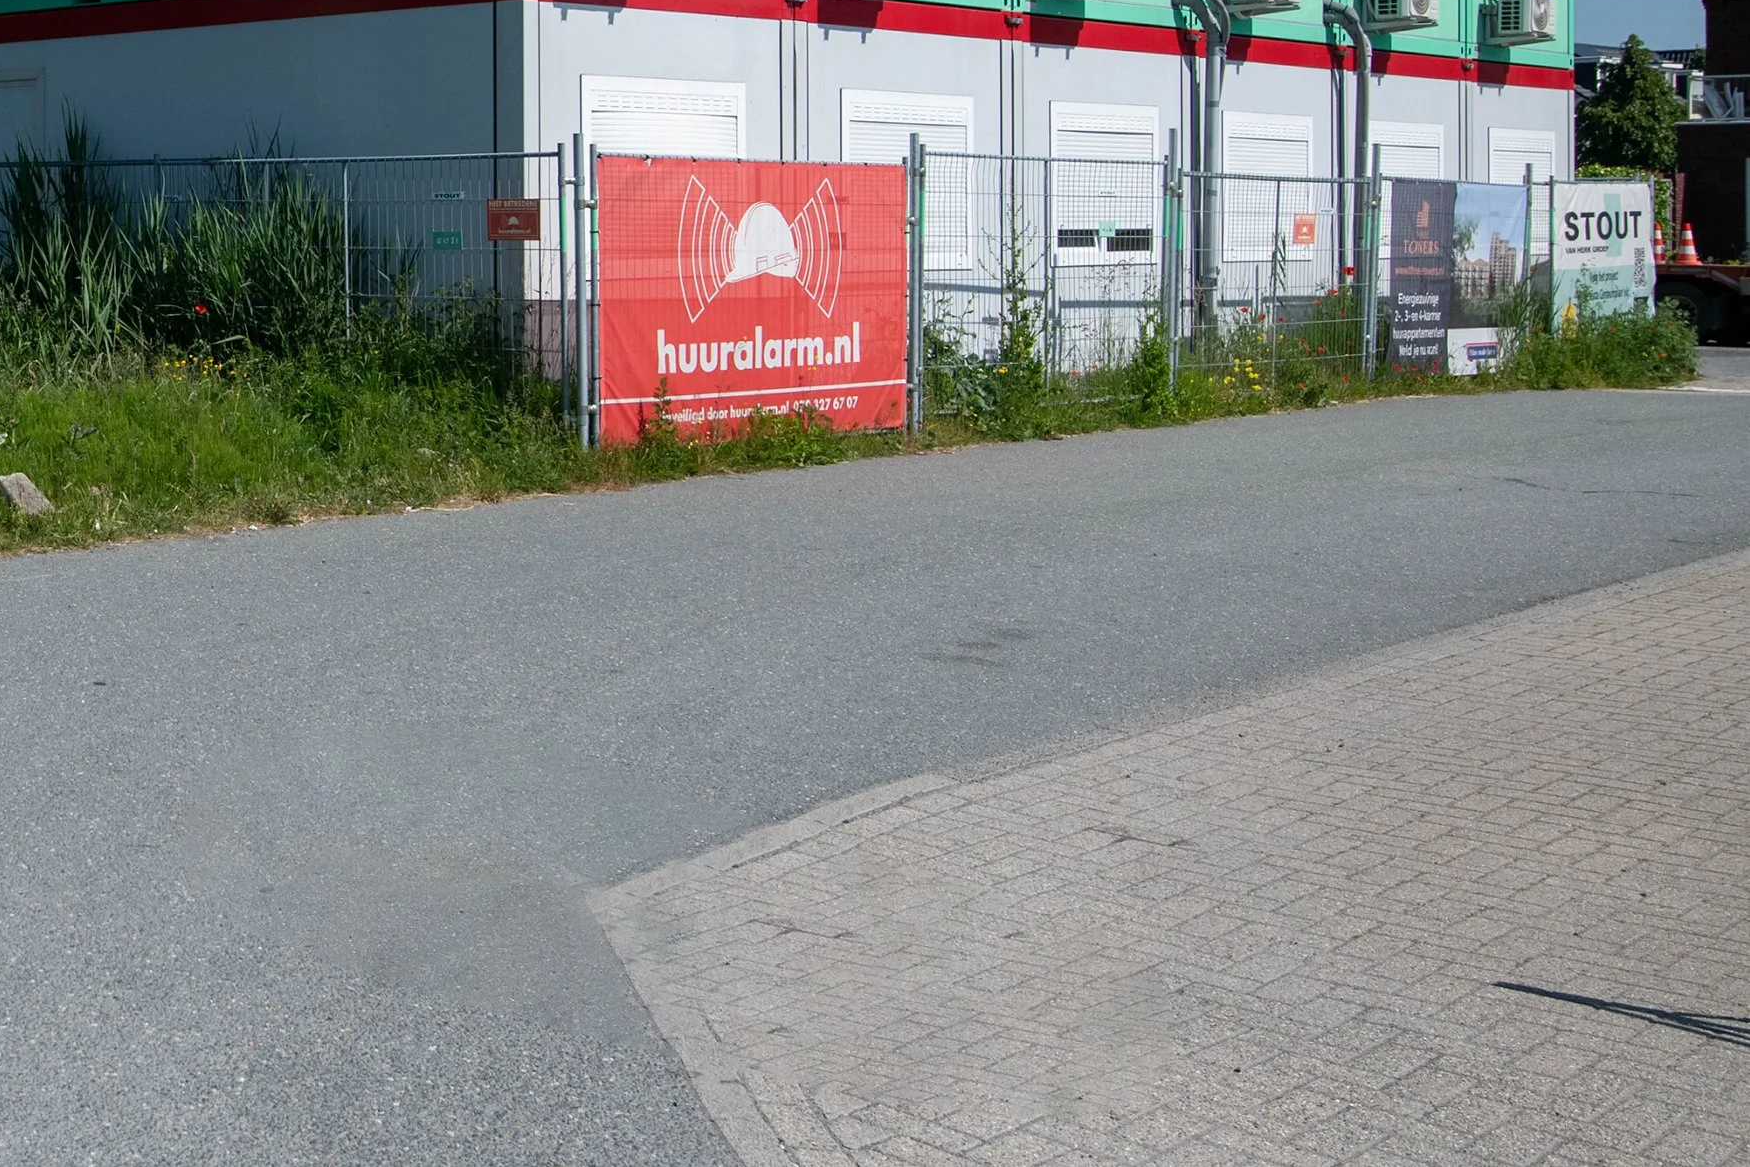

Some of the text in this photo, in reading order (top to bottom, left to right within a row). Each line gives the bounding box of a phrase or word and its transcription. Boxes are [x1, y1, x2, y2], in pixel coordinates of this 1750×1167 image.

[1564, 210, 1642, 241] STOUT
[1403, 240, 1439, 254] TOWERS
[1565, 245, 1610, 254] VAN HERK GROEP
[657, 321, 861, 374] huuralarm.nl
[707, 405, 729, 421] door
[813, 397, 831, 411] 327
[832, 396, 845, 411] 67
[846, 395, 859, 409] 07
